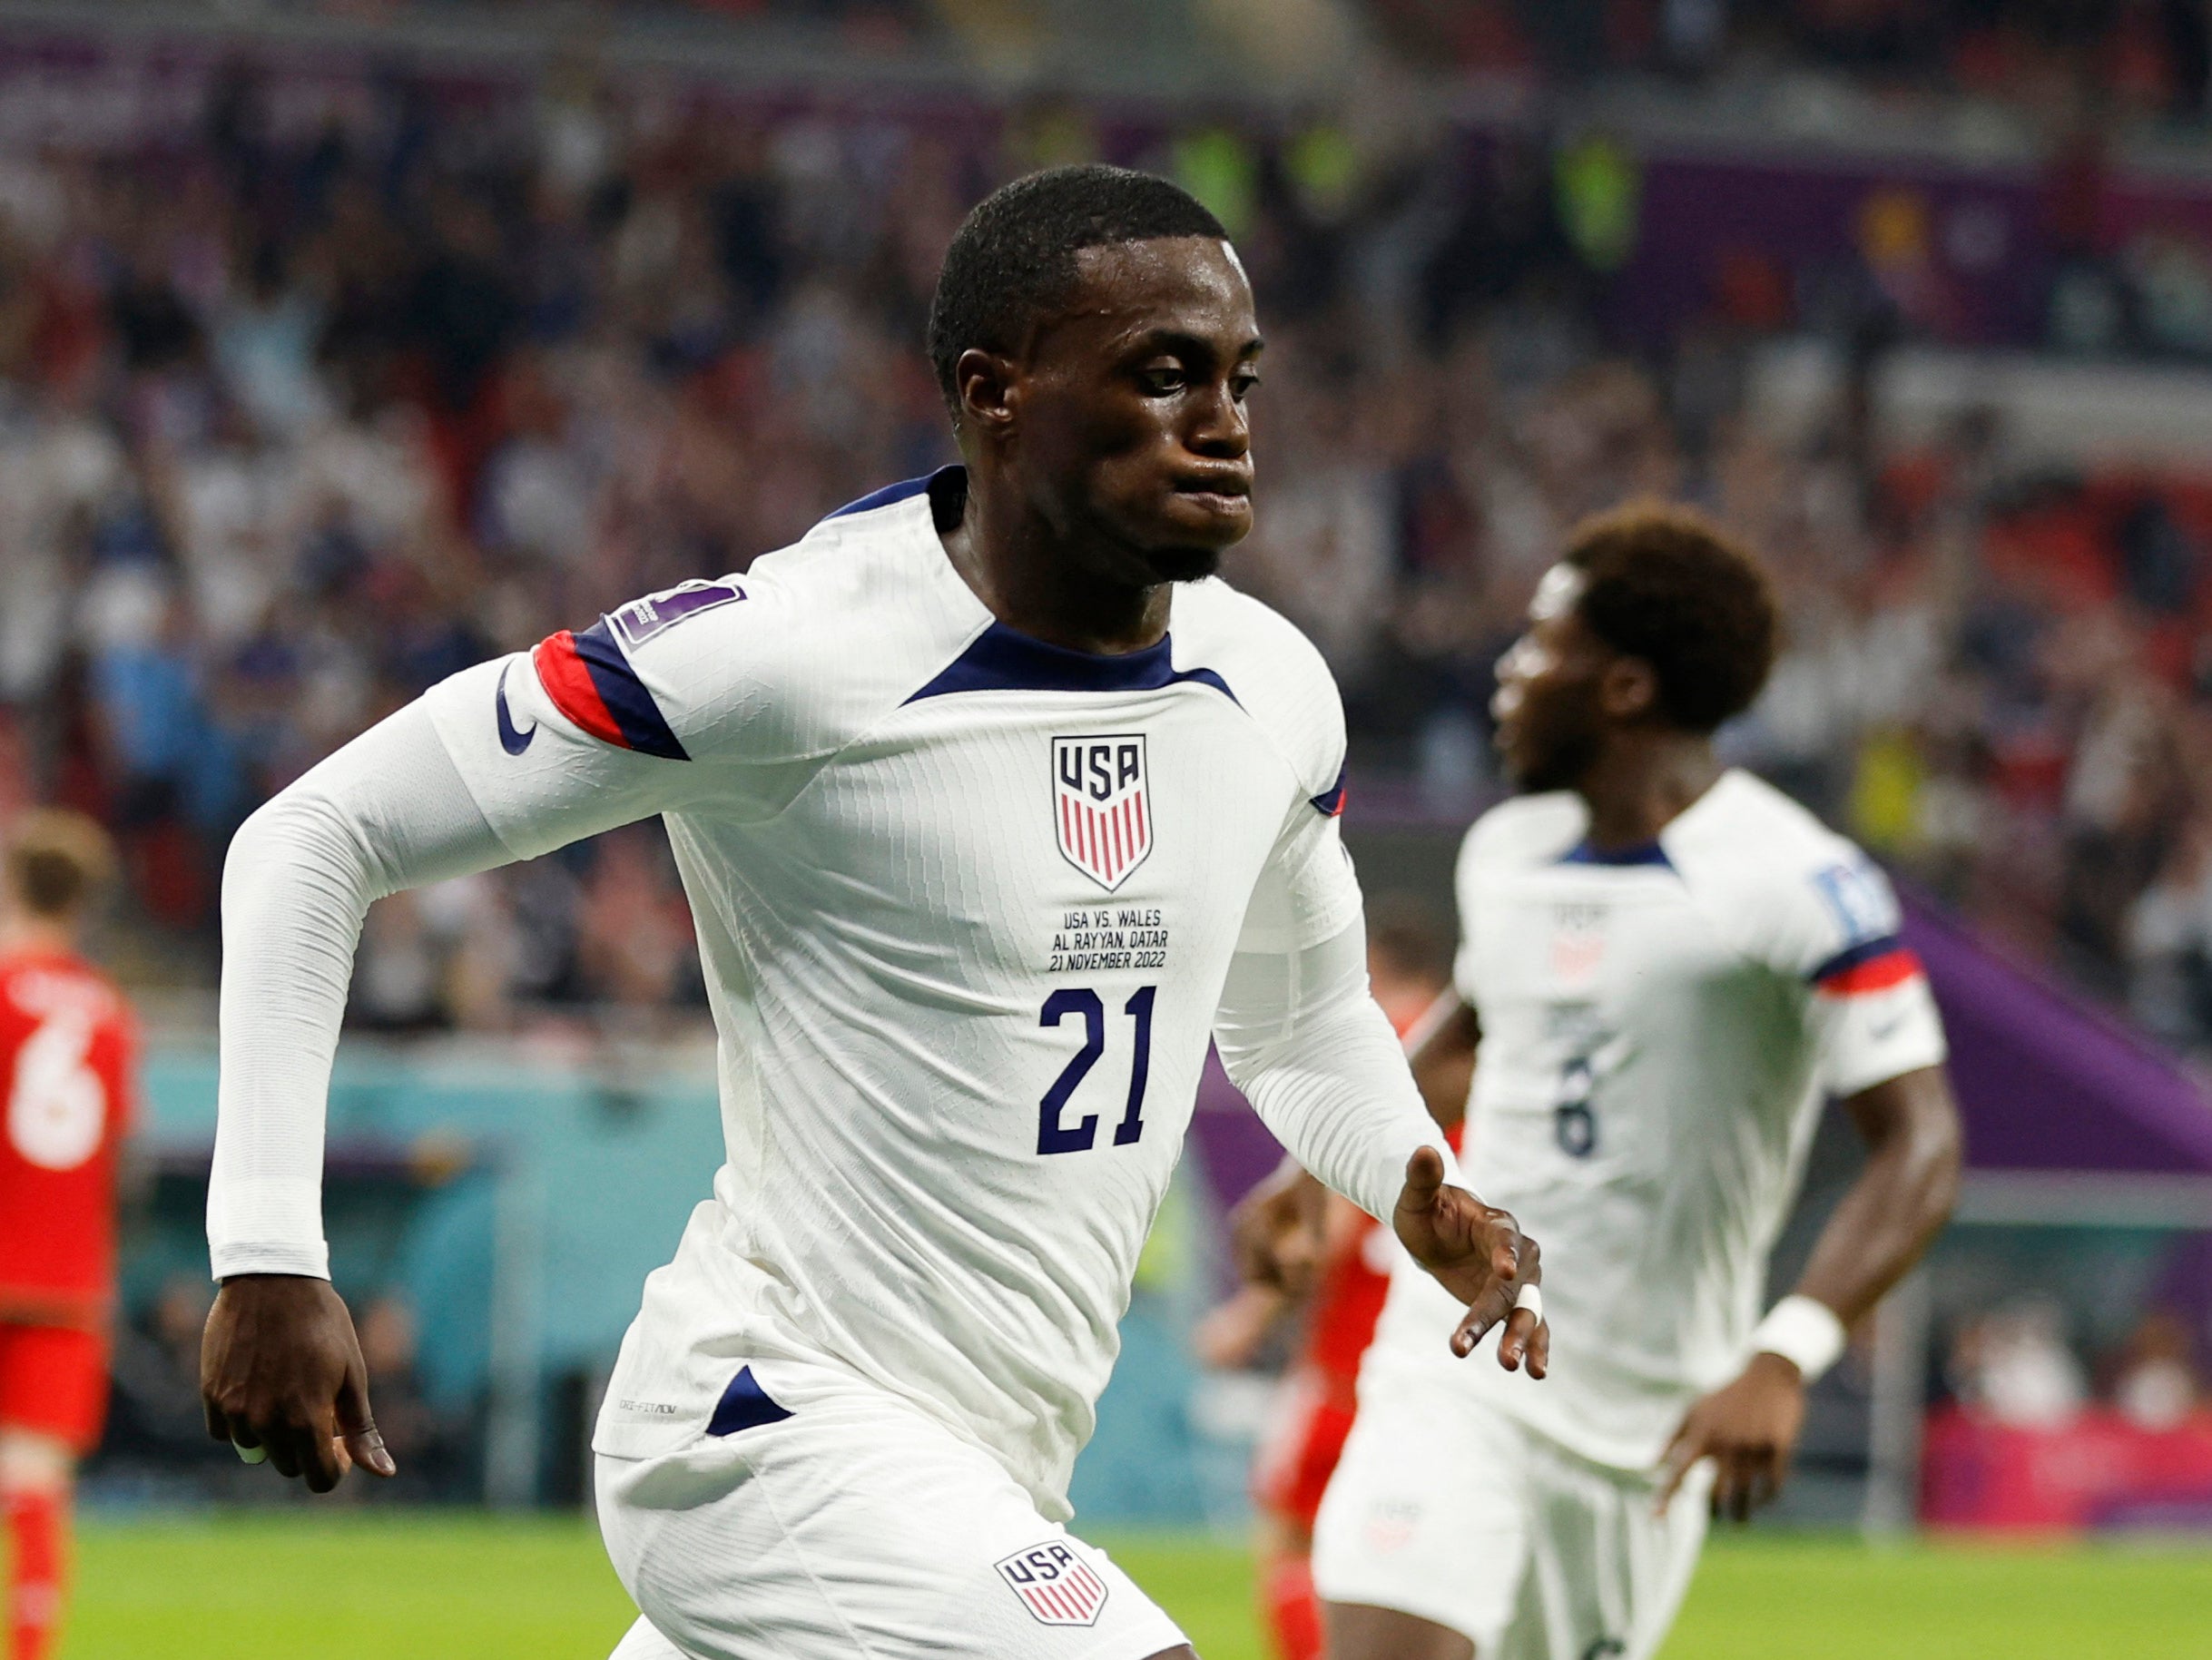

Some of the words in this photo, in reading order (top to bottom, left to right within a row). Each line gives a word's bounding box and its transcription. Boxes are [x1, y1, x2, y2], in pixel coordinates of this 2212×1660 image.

[1060, 745, 1139, 802] USA
[1064, 911, 1088, 929] USA
[1094, 910, 1112, 928] VS.
[1117, 909, 1161, 928] WALES
[1053, 934, 1069, 951] AL
[1074, 932, 1126, 950] RAYYAN,
[1129, 930, 1168, 948] QATAR
[1049, 955, 1063, 972] 21
[1067, 952, 1132, 971] NOVEMBER
[1134, 951, 1166, 968] 2022
[1036, 985, 1157, 1155] 21
[1004, 1545, 1073, 1584] USA
